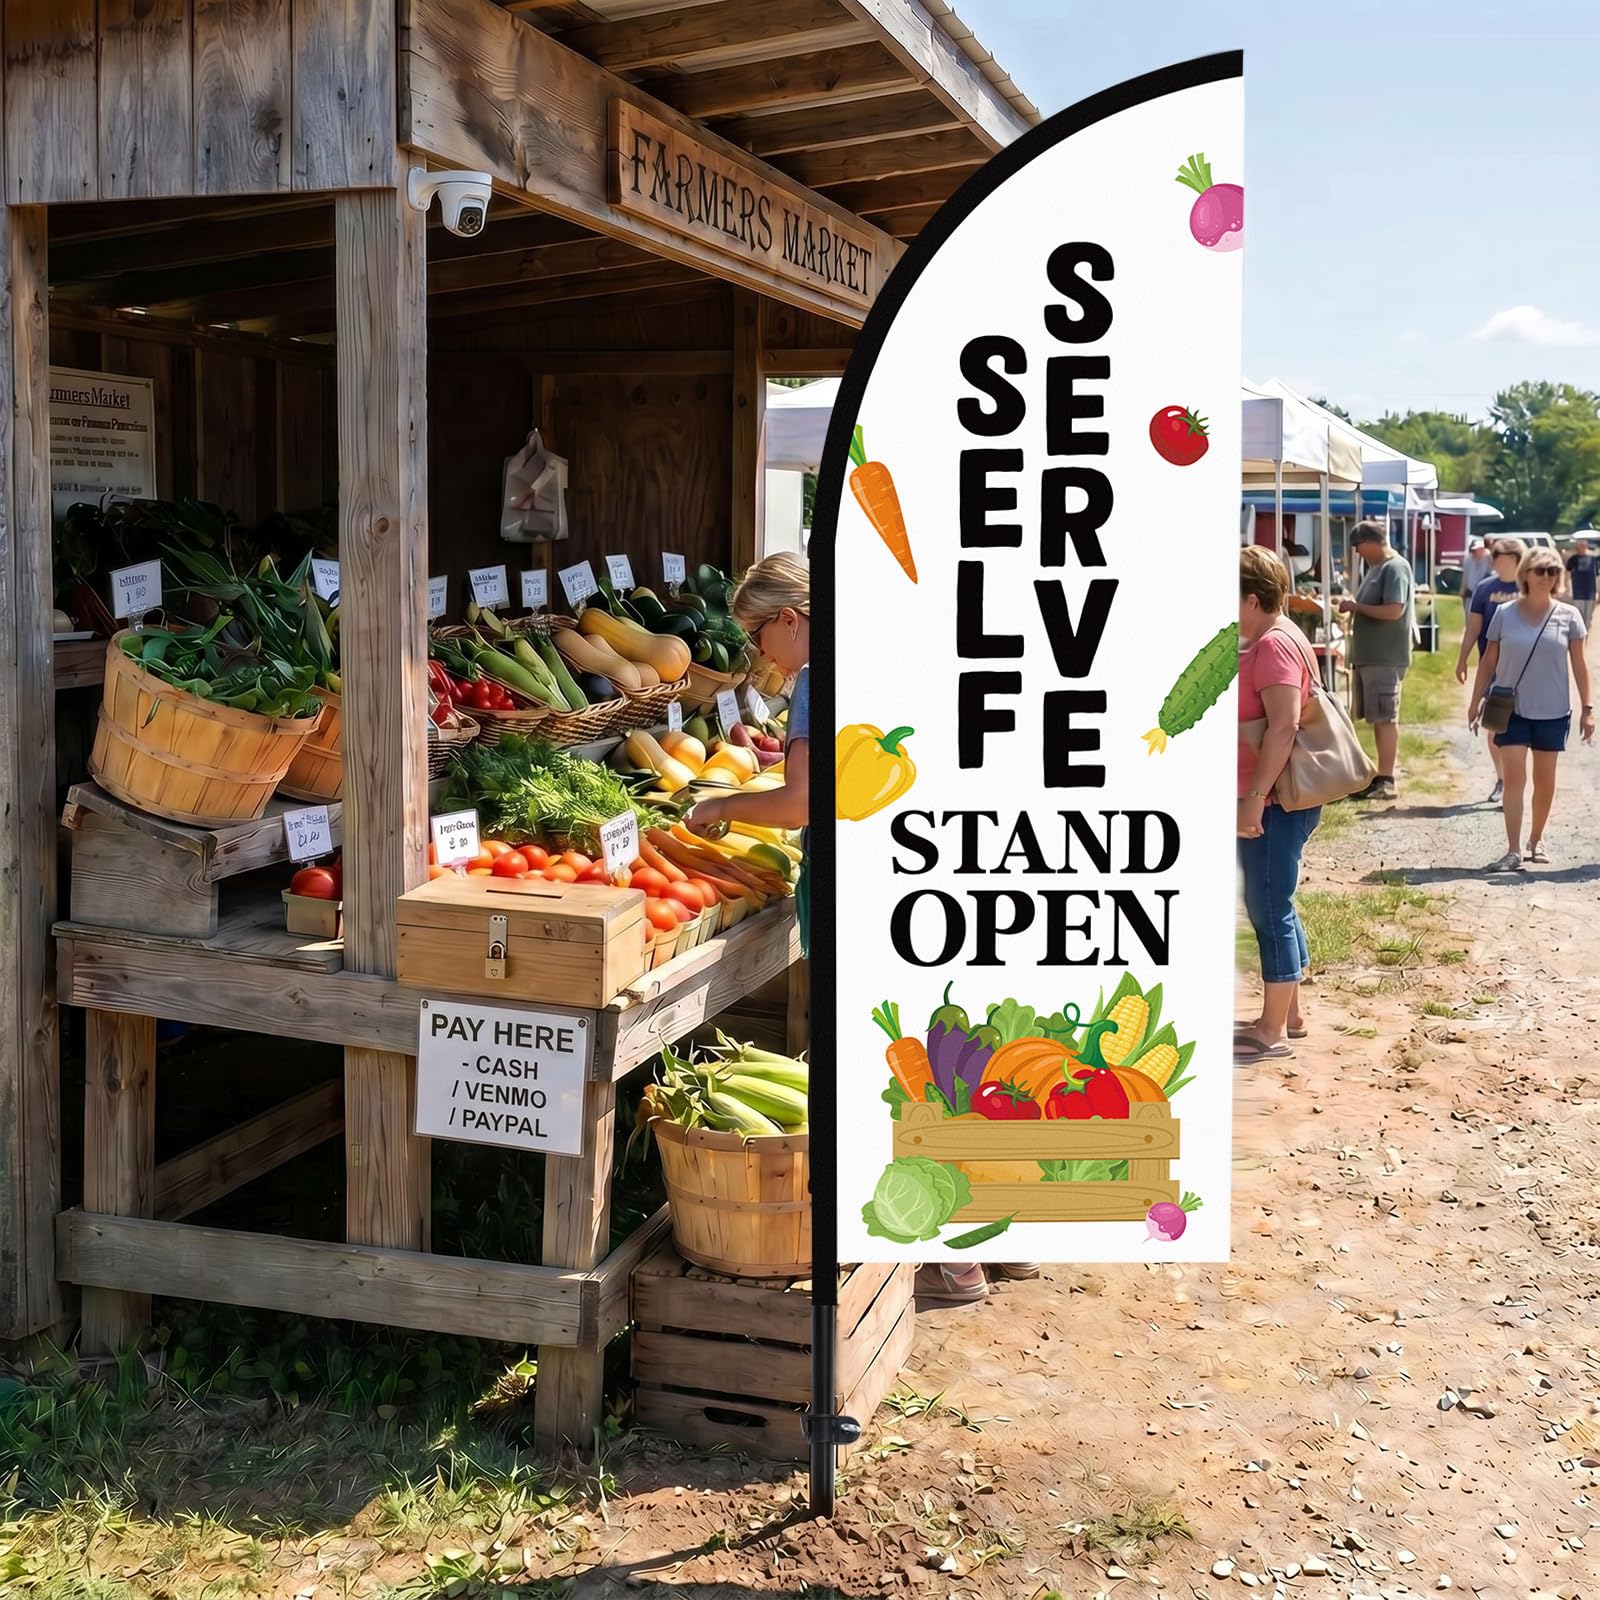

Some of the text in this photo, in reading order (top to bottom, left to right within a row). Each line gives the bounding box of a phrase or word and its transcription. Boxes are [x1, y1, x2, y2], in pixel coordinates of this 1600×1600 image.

[631, 129, 872, 295] FARMERS MARKET
[49, 387, 131, 408] rmers Market
[1033, 241, 1120, 789] SERVE
[956, 335, 1028, 770] SELF
[890, 809, 1181, 875] STAND
[890, 889, 1180, 968] OPEN
[431, 1013, 575, 1054] PAY HERE
[476, 1055, 538, 1080] CASH
[465, 1081, 547, 1109] VENMO
[463, 1109, 548, 1138] PAYPAL
